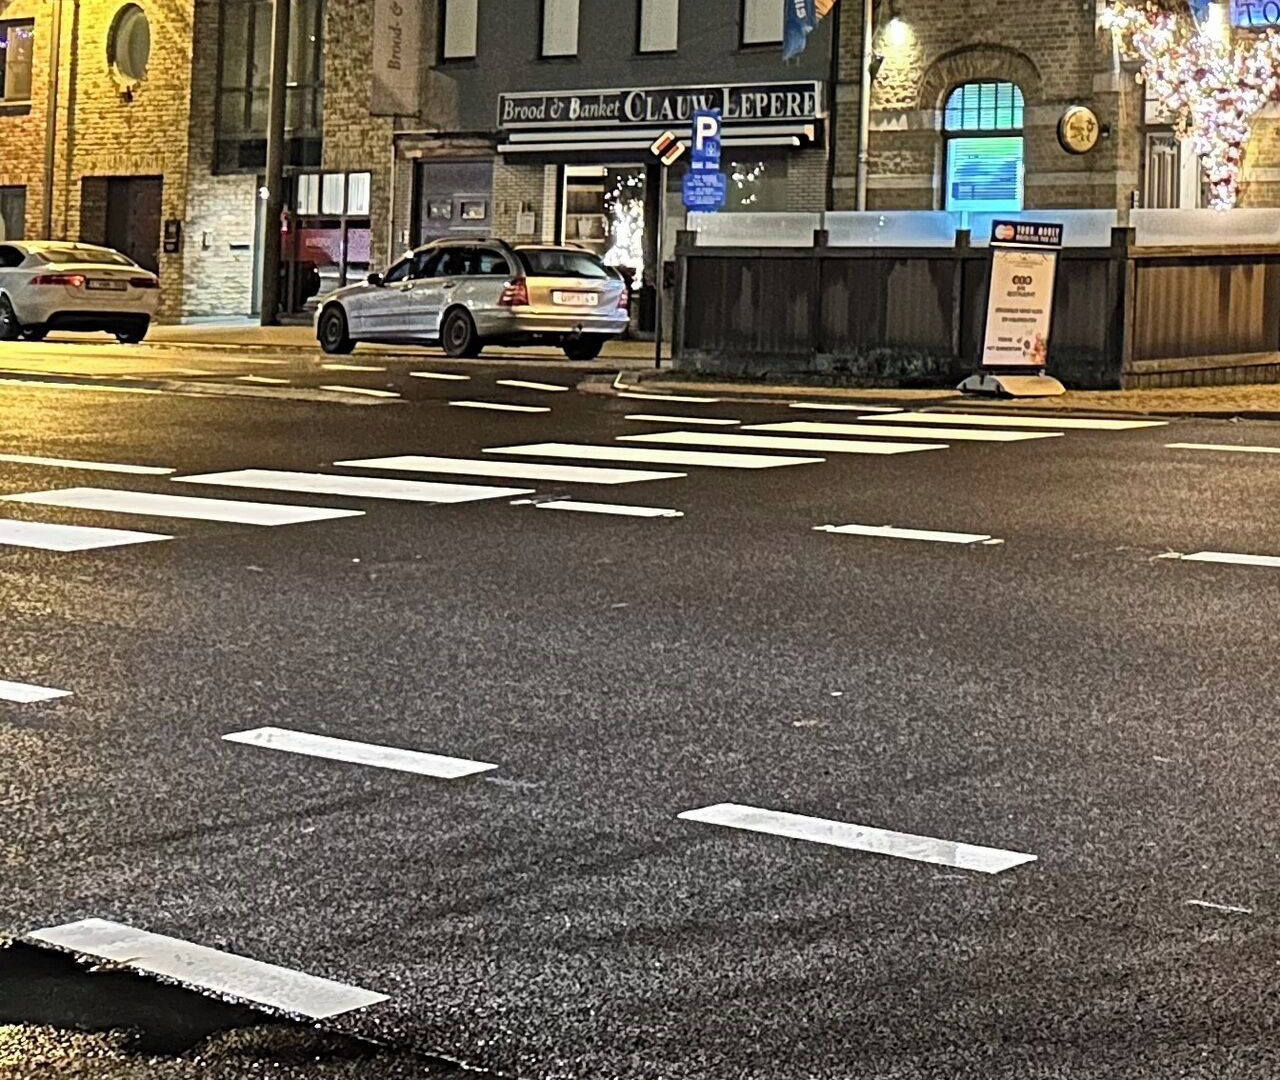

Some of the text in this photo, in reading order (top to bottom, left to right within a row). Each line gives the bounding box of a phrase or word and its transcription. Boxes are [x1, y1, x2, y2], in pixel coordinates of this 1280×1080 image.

[389, 2, 403, 16] &
[502, 97, 546, 120] Brood
[550, 98, 564, 119] &
[568, 94, 621, 120] Banket
[696, 116, 718, 151] P
